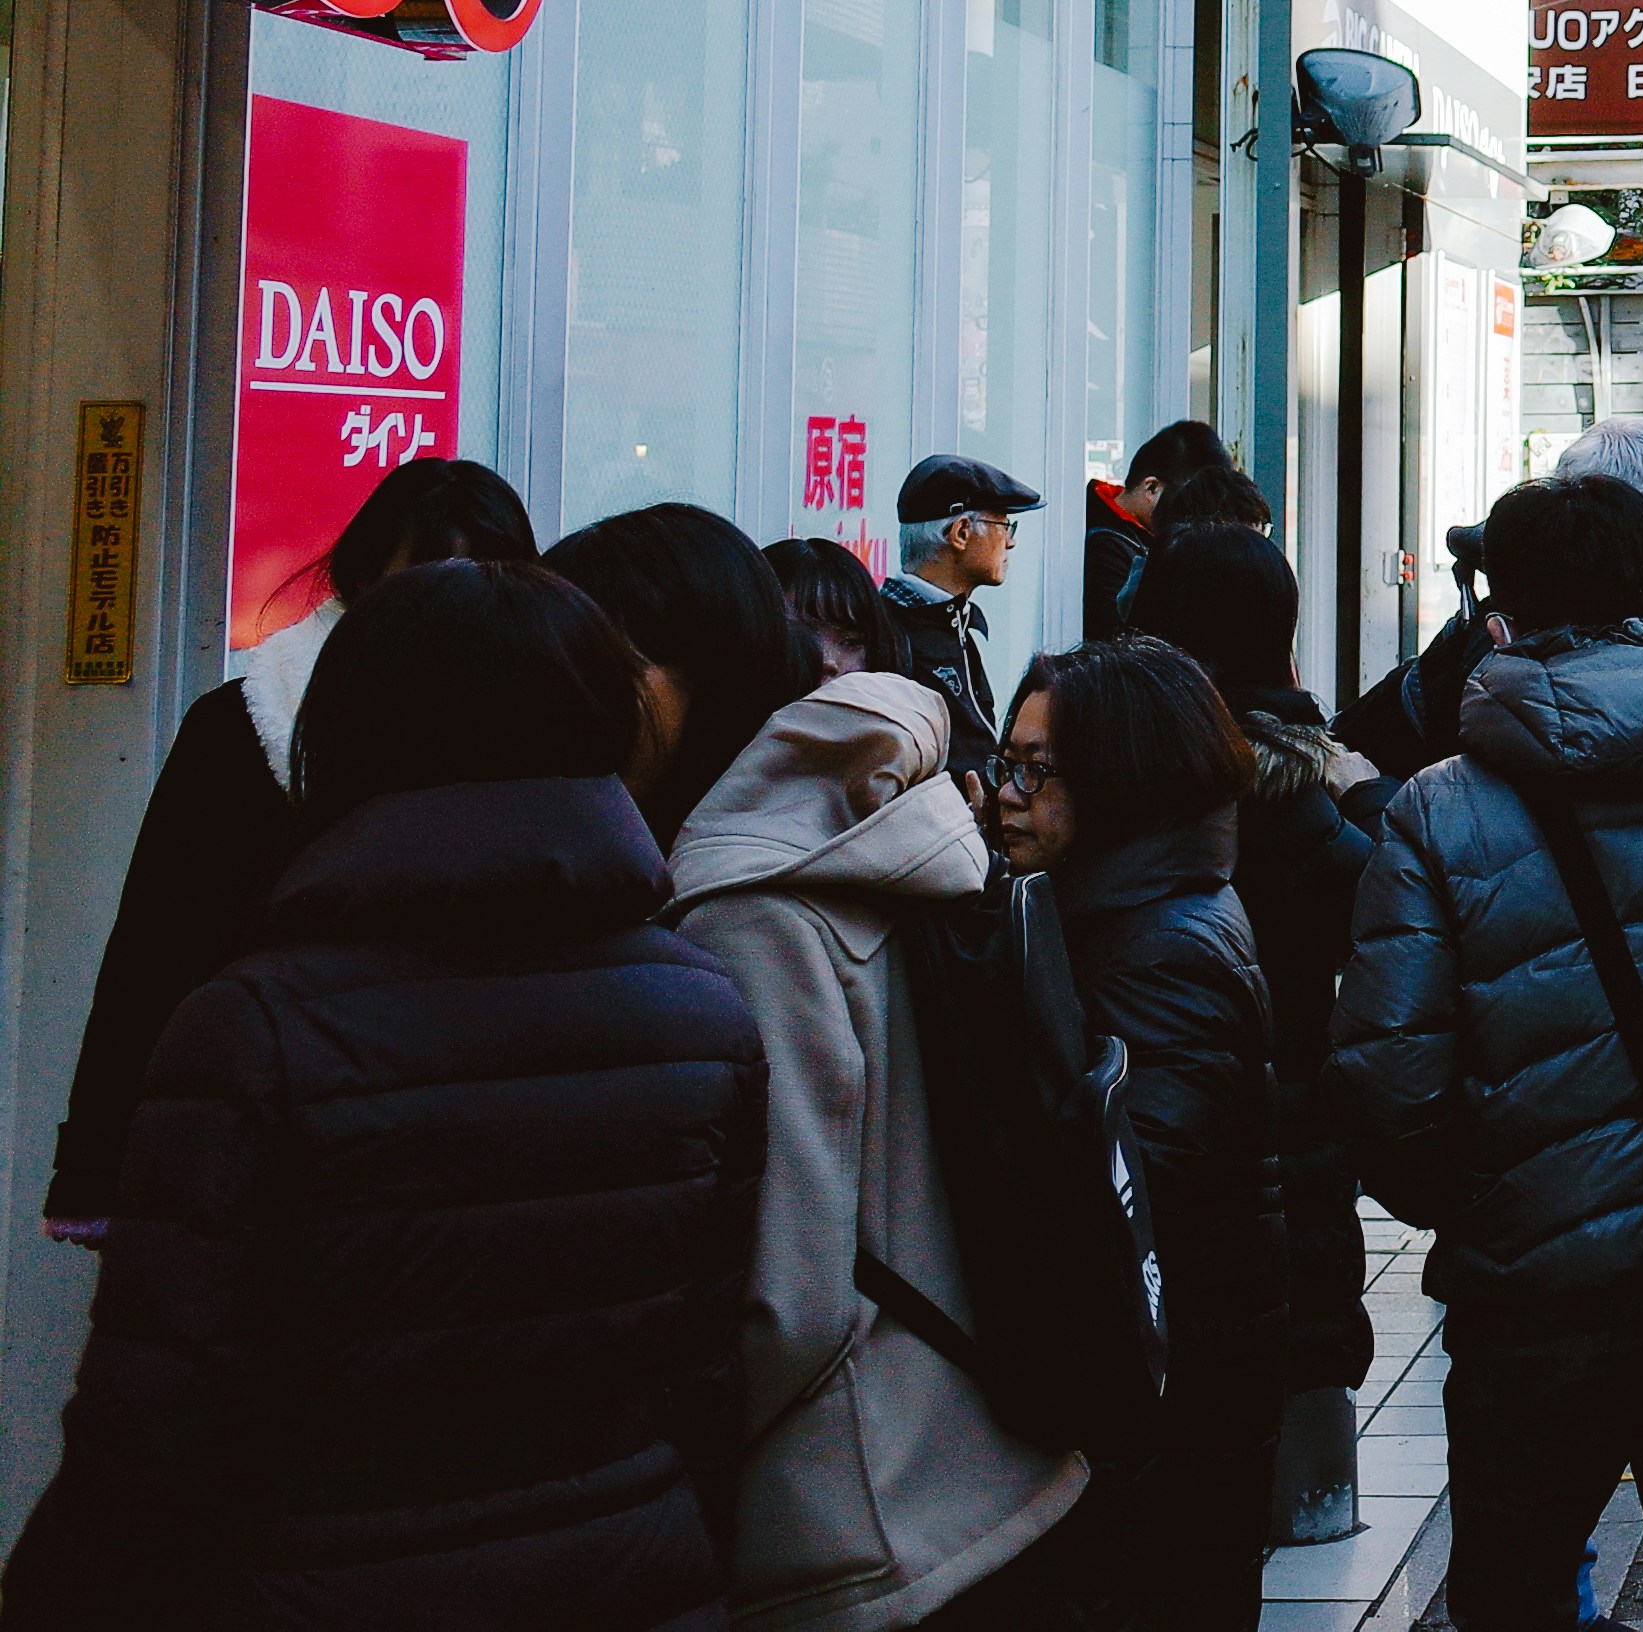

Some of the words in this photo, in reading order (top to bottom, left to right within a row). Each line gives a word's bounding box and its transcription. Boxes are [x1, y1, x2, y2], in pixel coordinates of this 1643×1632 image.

[255, 279, 446, 381] DAISO
[109, 451, 132, 519] 万引き
[341, 404, 436, 468] ダイソー
[804, 414, 868, 512] 原宿
[85, 524, 120, 655] 防止モデル店
